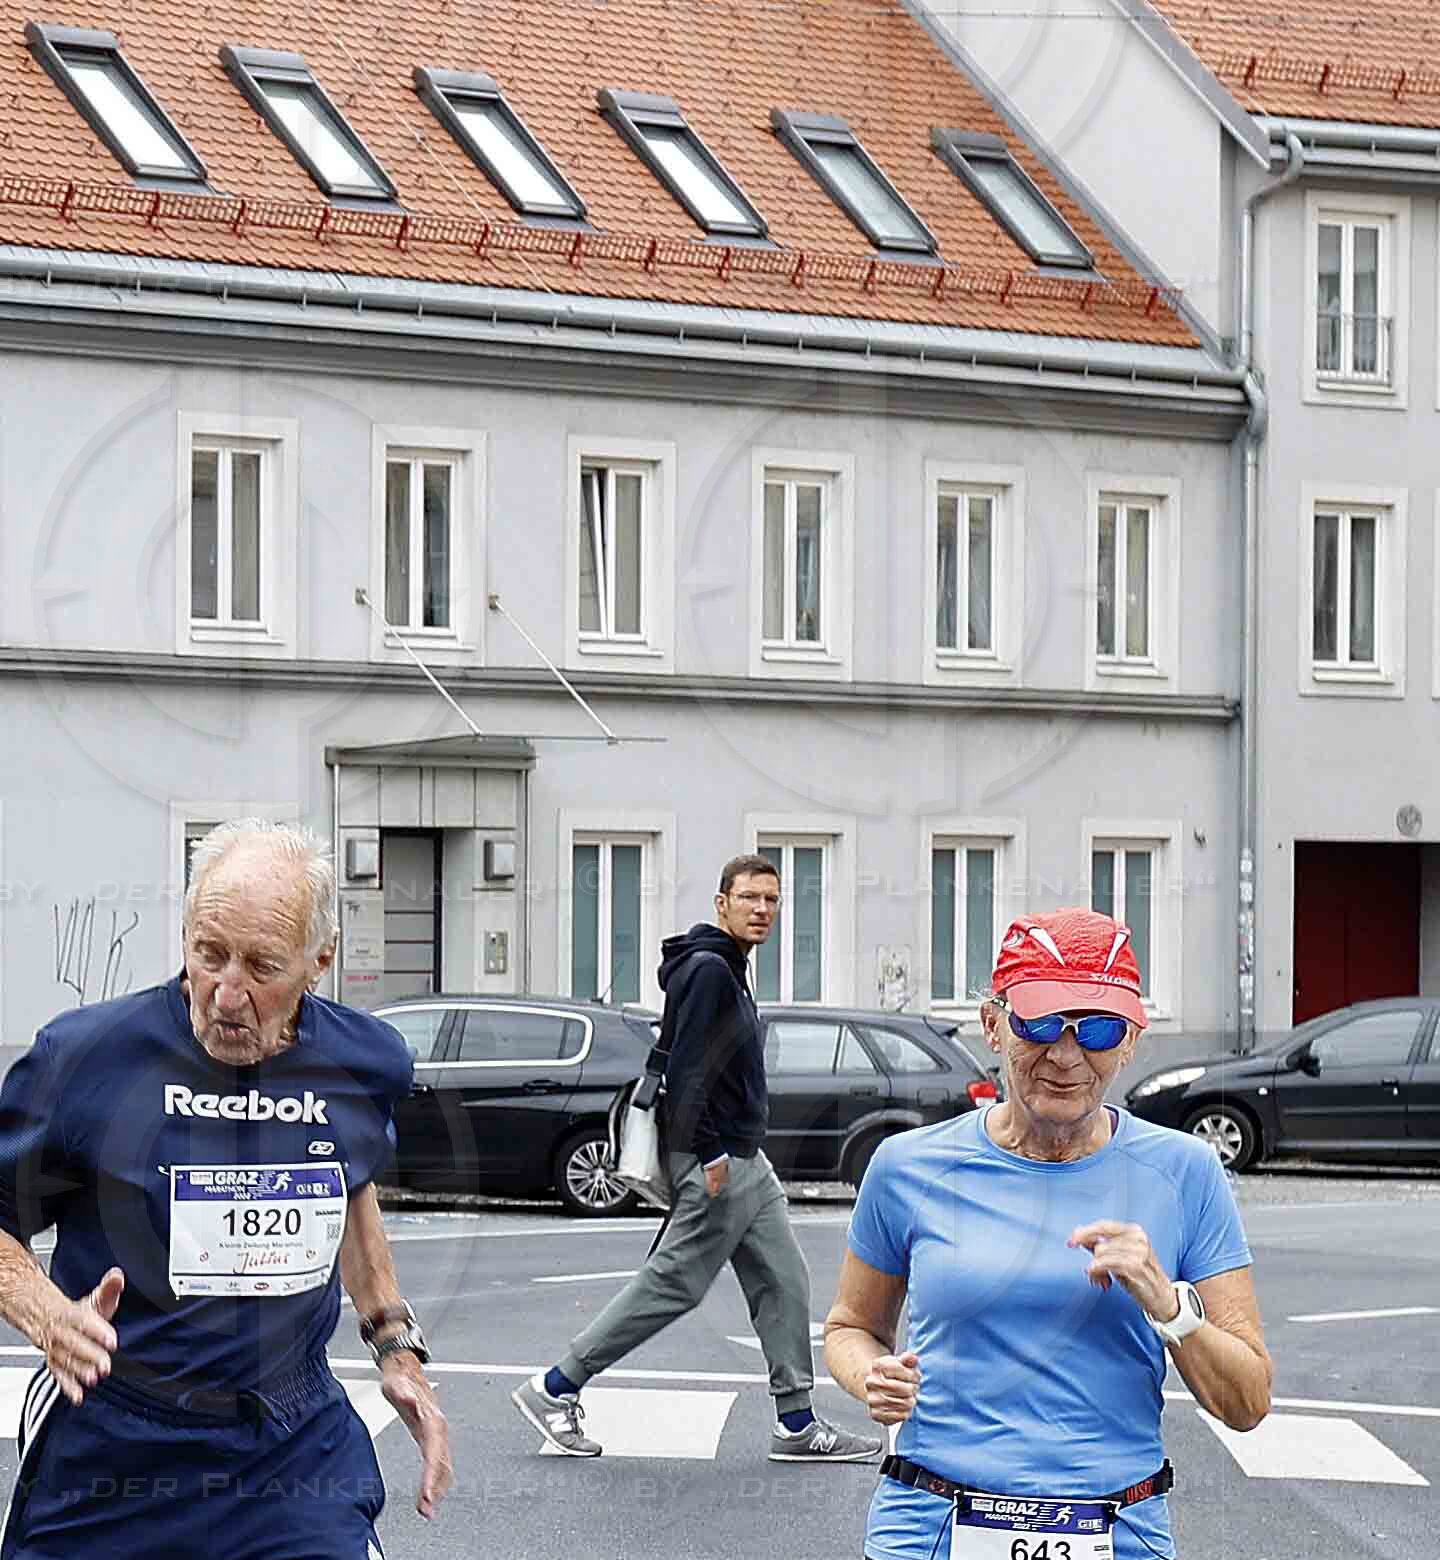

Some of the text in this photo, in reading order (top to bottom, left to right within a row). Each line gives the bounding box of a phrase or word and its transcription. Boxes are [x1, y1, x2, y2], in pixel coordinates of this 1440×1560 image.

[164, 1084, 329, 1125] Reebok
[214, 1171, 259, 1185] GRAZ
[222, 1208, 302, 1237] 1820
[995, 1501, 1039, 1516] GRAZ
